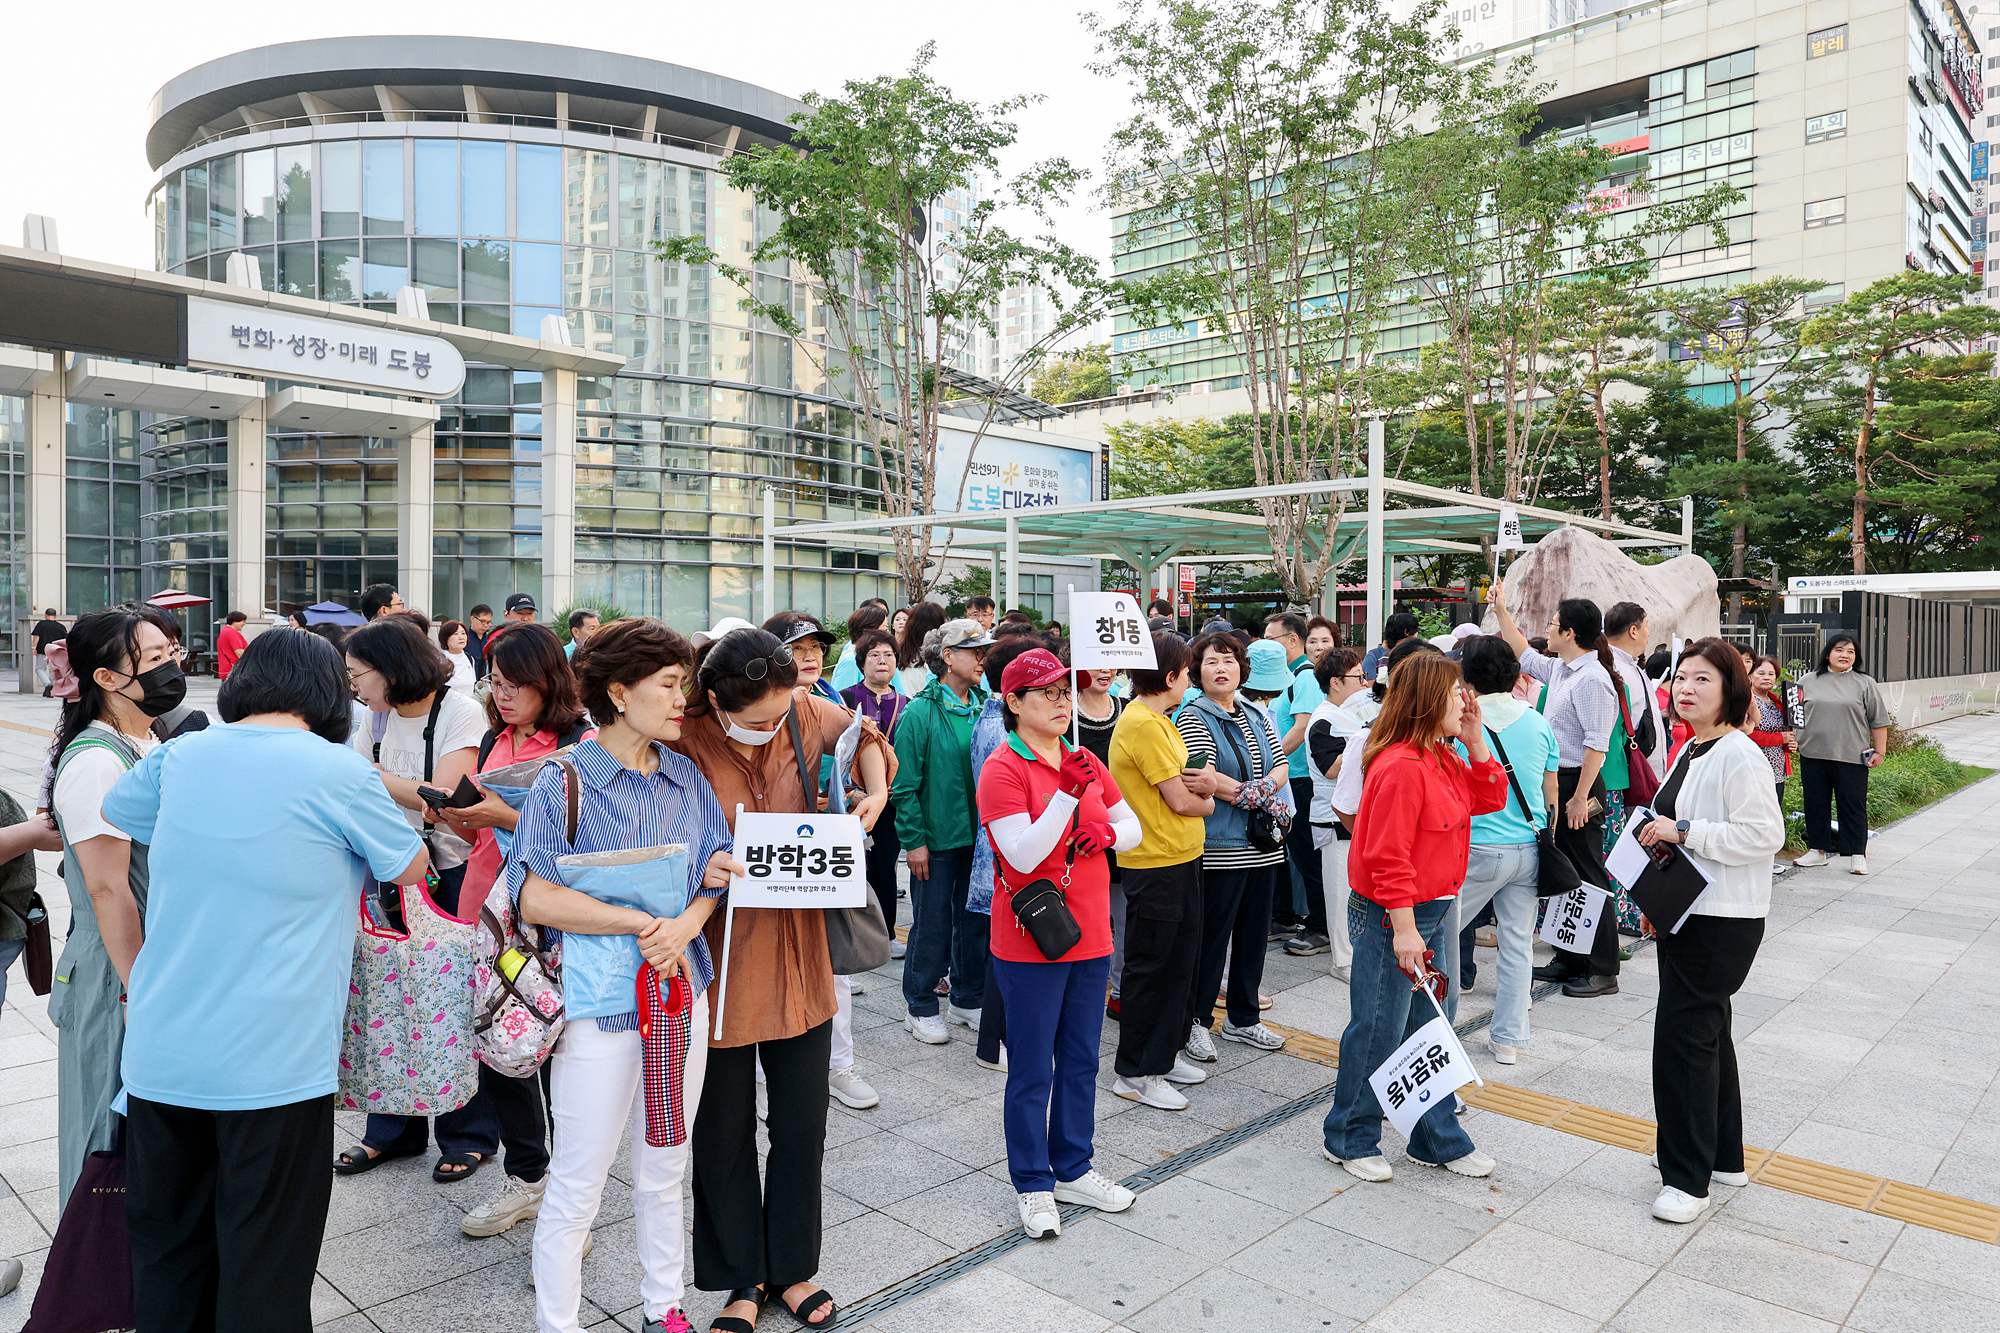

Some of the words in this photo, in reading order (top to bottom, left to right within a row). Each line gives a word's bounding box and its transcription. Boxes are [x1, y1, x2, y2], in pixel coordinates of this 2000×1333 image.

[1443, 0, 1497, 28] 래미안
[1811, 34, 1844, 57] 발레
[1808, 113, 1843, 133] 교회
[1687, 135, 1748, 161] 주님의
[231, 324, 378, 366] 변화·성장·미래
[387, 348, 432, 380] 도봉
[970, 462, 1000, 477] 민선9기
[1024, 465, 1040, 477] 문화와
[1042, 468, 1059, 480] 경제가
[1028, 479, 1040, 489] 살아
[1040, 480, 1046, 489] 숨
[1047, 481, 1058, 491] 쉬는
[1096, 617, 1141, 644] 창1동
[745, 844, 855, 878] 방학3동
[767, 885, 796, 893] 비영리단체
[796, 885, 820, 893] 역량강화
[820, 885, 837, 893] 워크숍
[1386, 1044, 1451, 1110] 쌍문1동
